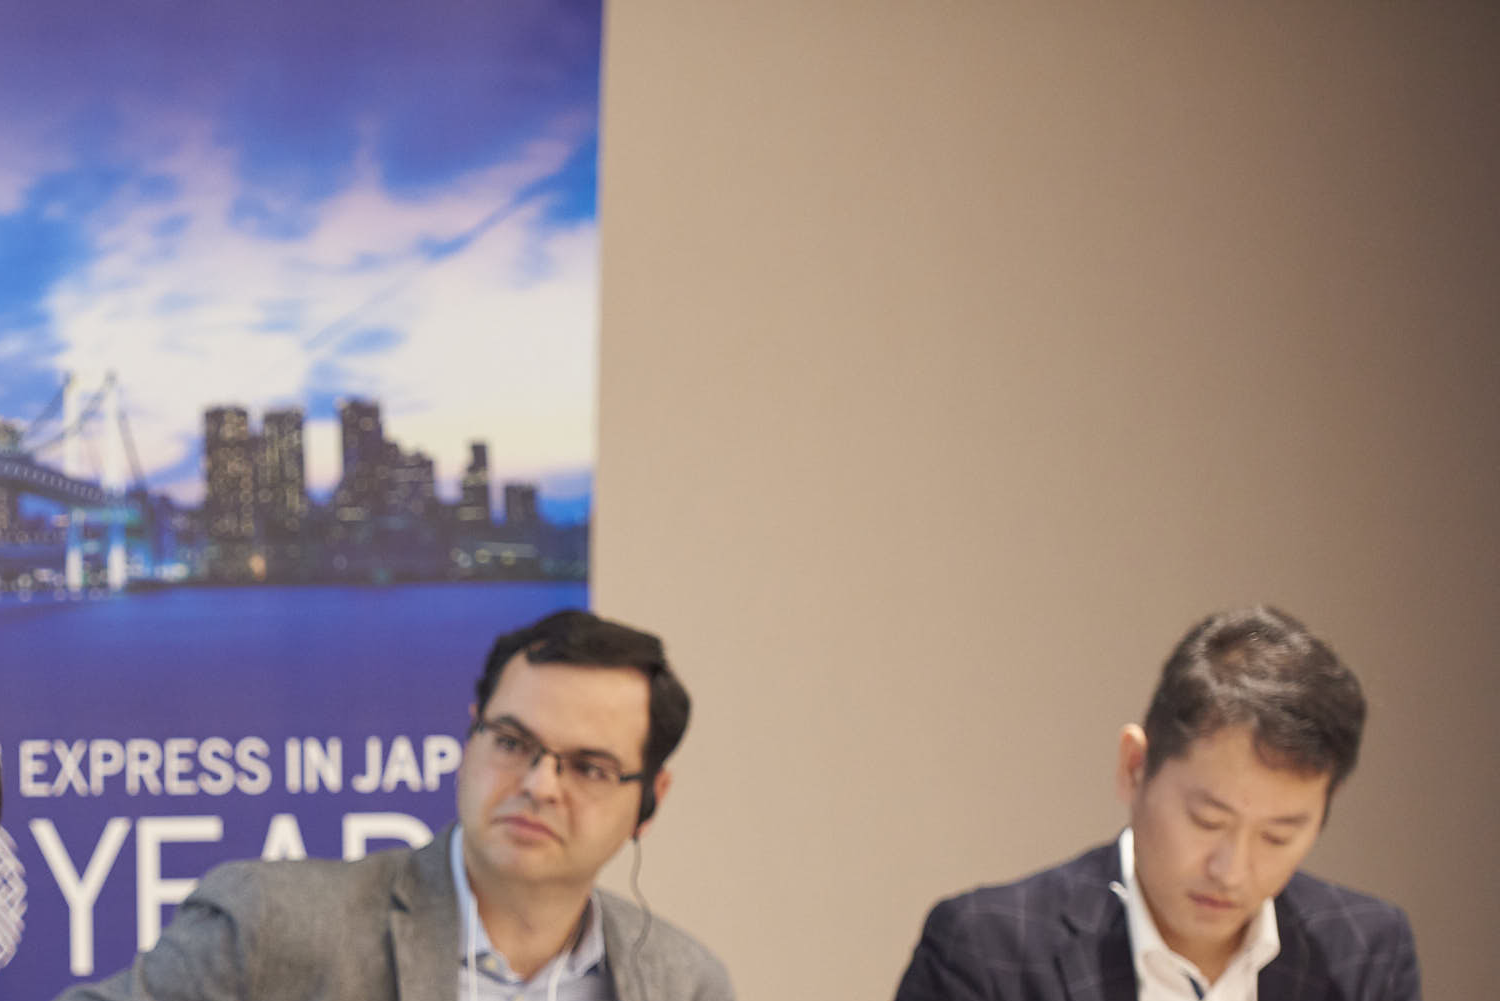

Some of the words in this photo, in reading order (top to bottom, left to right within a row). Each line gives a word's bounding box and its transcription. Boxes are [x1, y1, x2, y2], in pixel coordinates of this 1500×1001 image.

[18, 736, 273, 797] EXPRESS
[285, 736, 343, 794] IN
[351, 734, 464, 794] JAP
